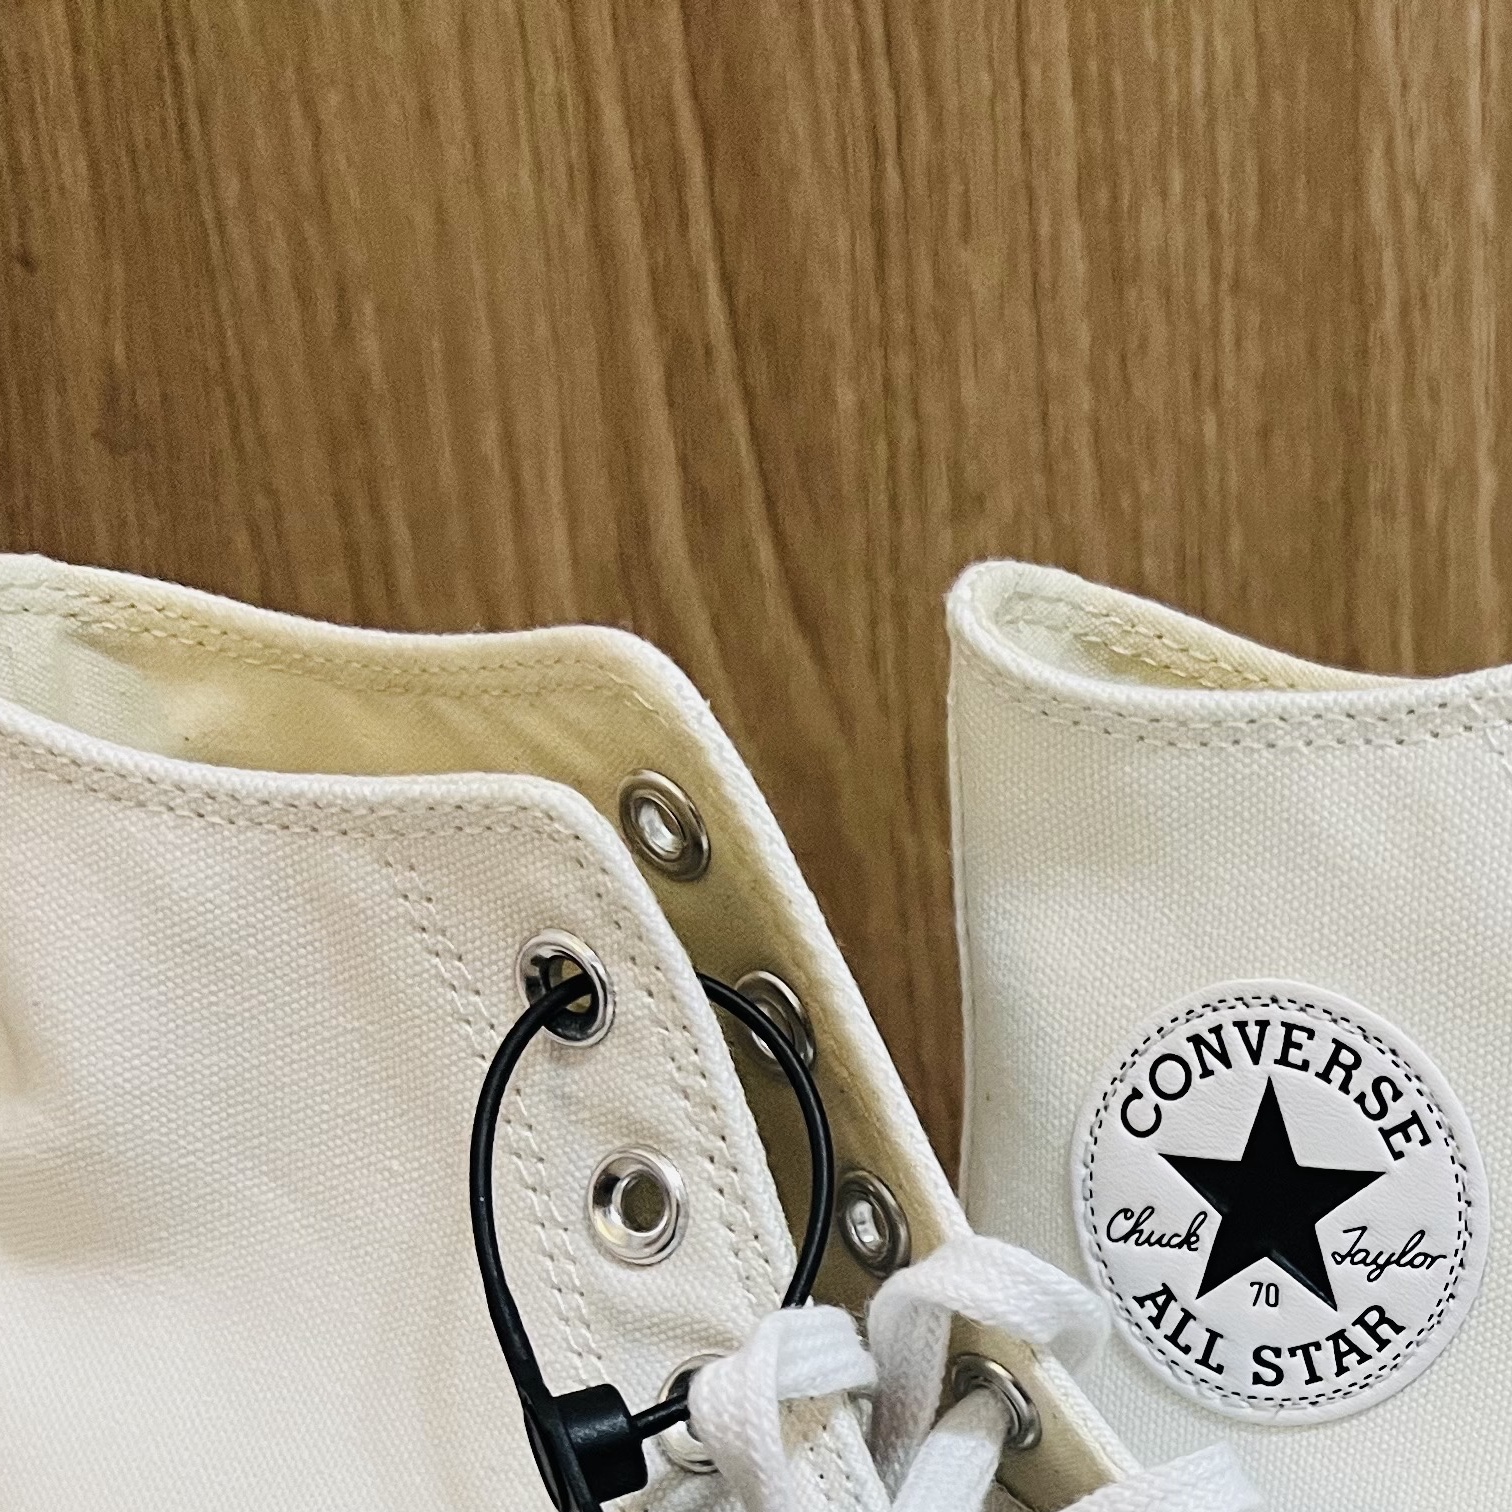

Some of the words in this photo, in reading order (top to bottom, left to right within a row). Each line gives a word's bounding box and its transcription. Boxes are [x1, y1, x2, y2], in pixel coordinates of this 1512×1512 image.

[1120, 1019, 1432, 1161] CONVERSE
[1106, 1206, 1208, 1252] Chuck
[1331, 1225, 1447, 1282] Taylor
[1133, 1282, 1226, 1376] ALL
[1251, 1303, 1407, 1388] STAR
[1249, 1281, 1280, 1308] 70
